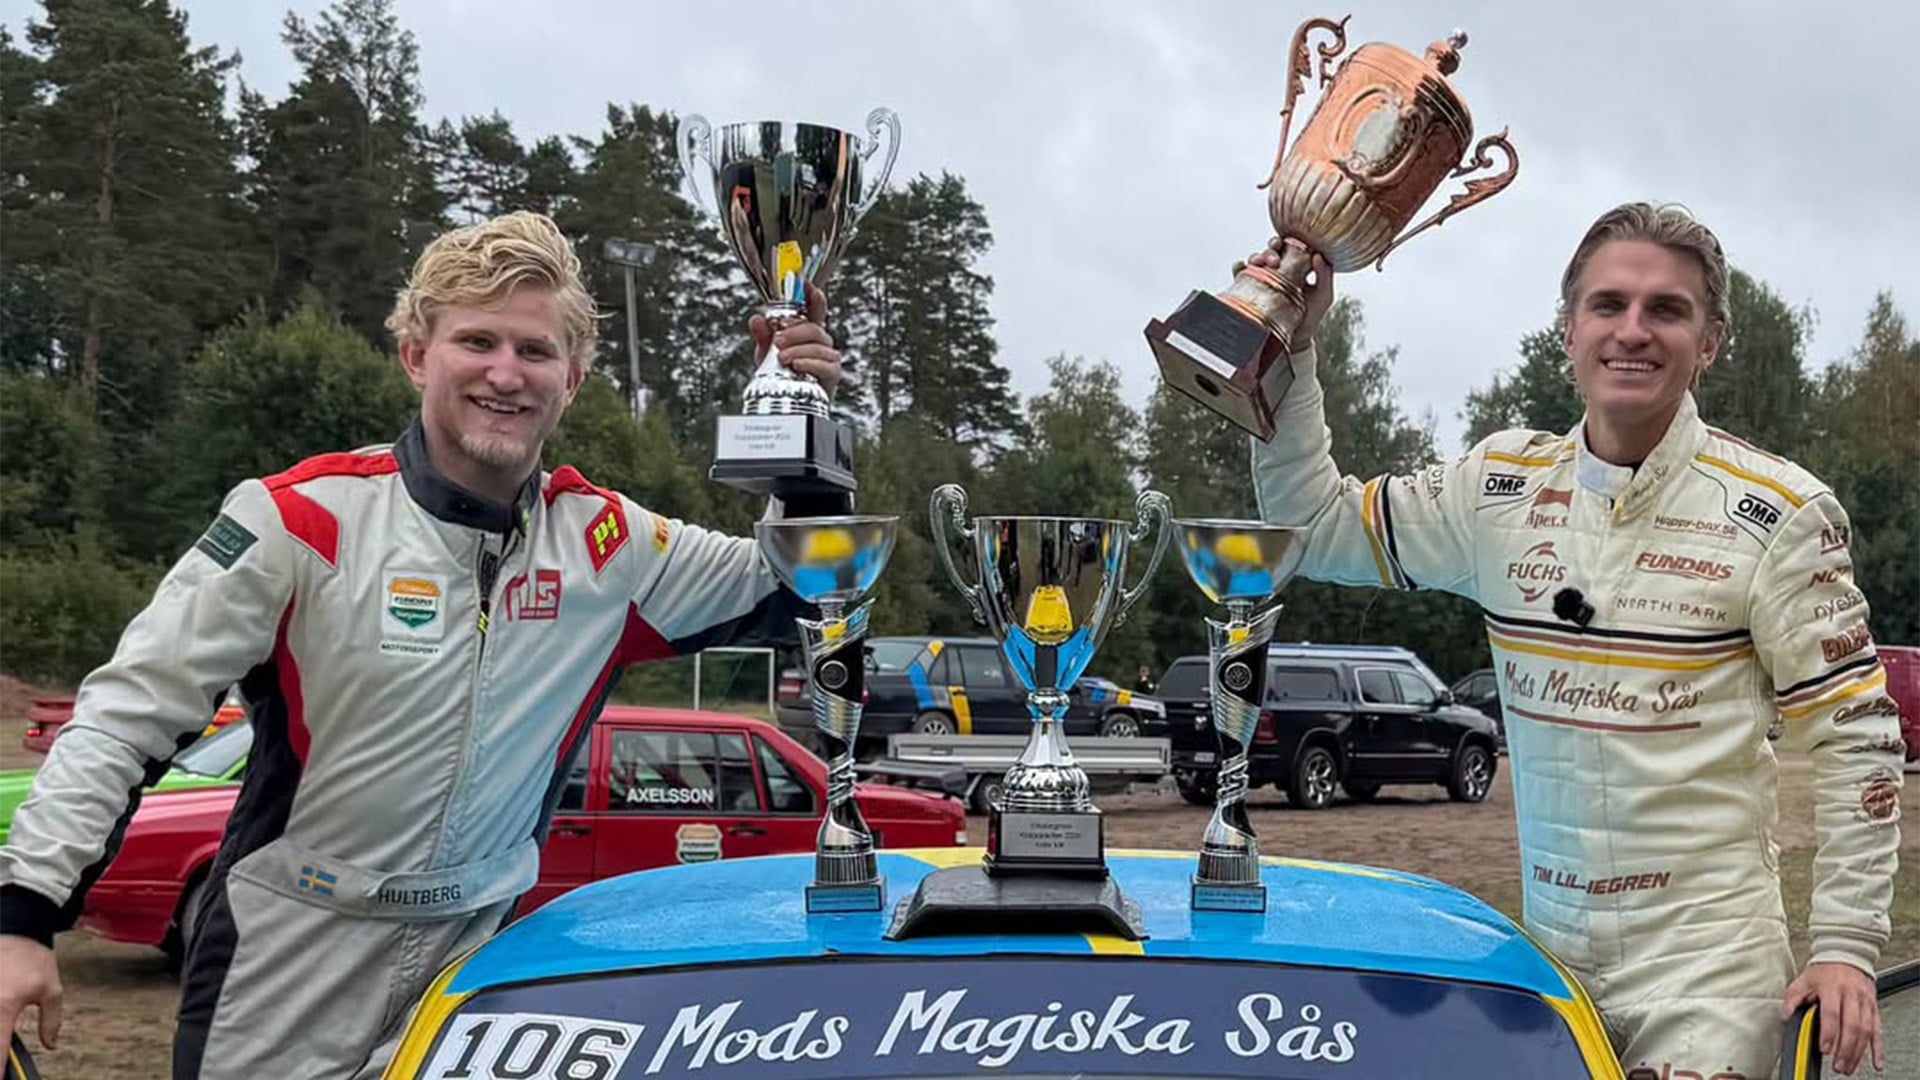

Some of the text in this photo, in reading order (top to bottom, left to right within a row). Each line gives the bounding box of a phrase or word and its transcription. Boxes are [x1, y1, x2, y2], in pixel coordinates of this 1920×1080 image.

[1485, 477, 1526, 493] OMP
[1737, 497, 1779, 527] OMP
[1507, 562, 1567, 582] FUCHS
[1636, 551, 1735, 579] FUNDINS
[1679, 602, 1728, 622] PARK
[1541, 669, 1639, 713] Magiska
[1652, 680, 1704, 714] Sås
[626, 788, 714, 803] AXELSSON
[1533, 865, 1552, 883] TIM
[378, 884, 461, 905] HULTBERG
[442, 989, 1358, 1080] 106 Mods Magiska Sås
